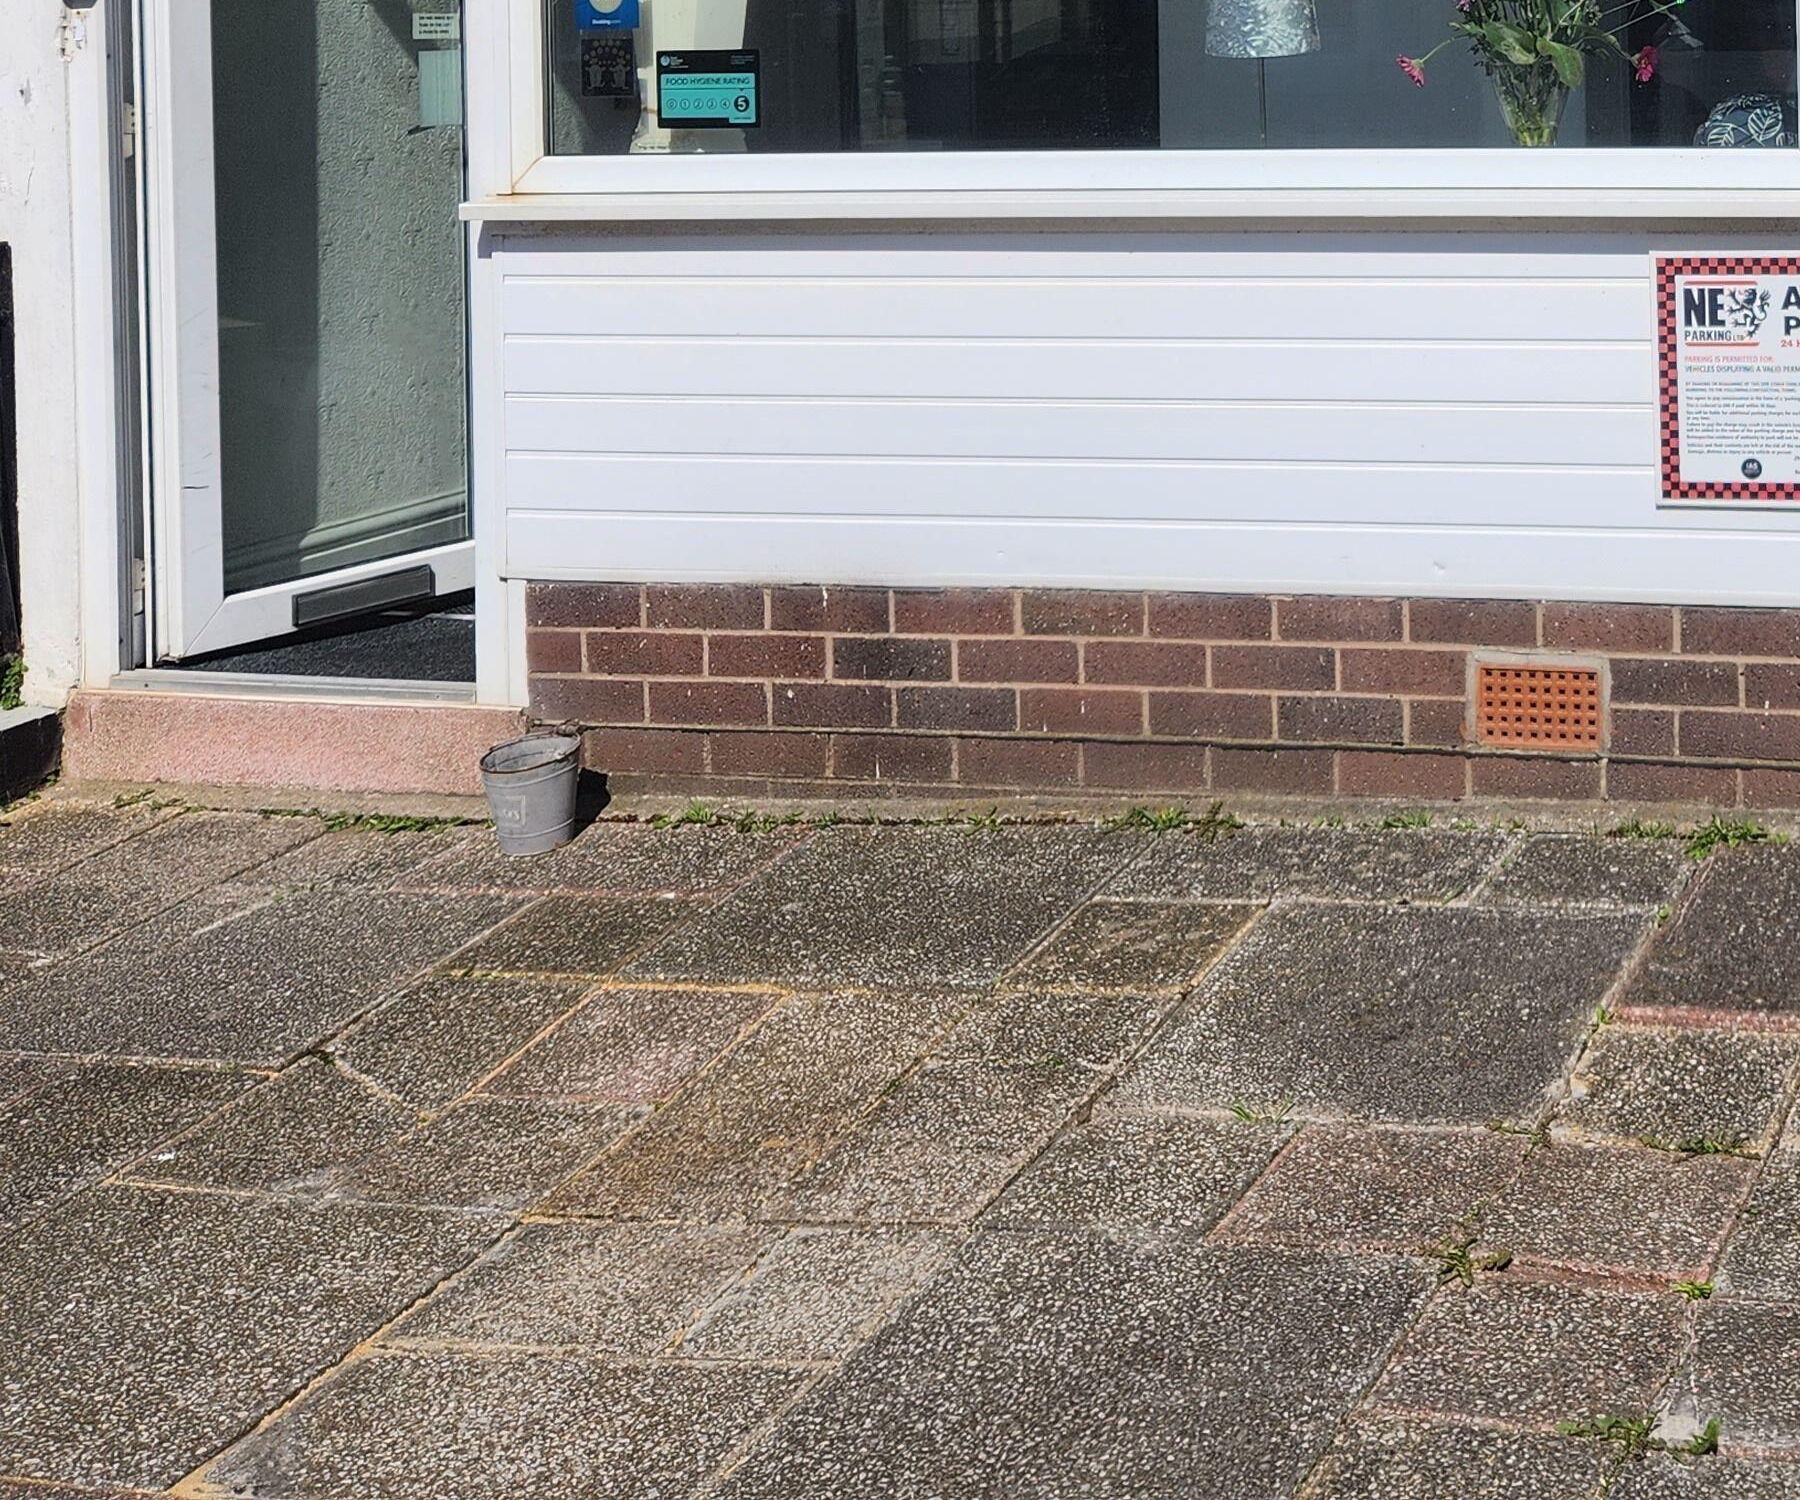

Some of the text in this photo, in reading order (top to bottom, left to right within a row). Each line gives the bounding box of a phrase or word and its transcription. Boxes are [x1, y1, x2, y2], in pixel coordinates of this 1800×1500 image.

[665, 77, 751, 86] FOOD HYGIENE RATING
[737, 97, 747, 111] 5
[1683, 287, 1726, 327] NE
[1684, 329, 1732, 342] PARKING
[1780, 339, 1793, 348] 24
